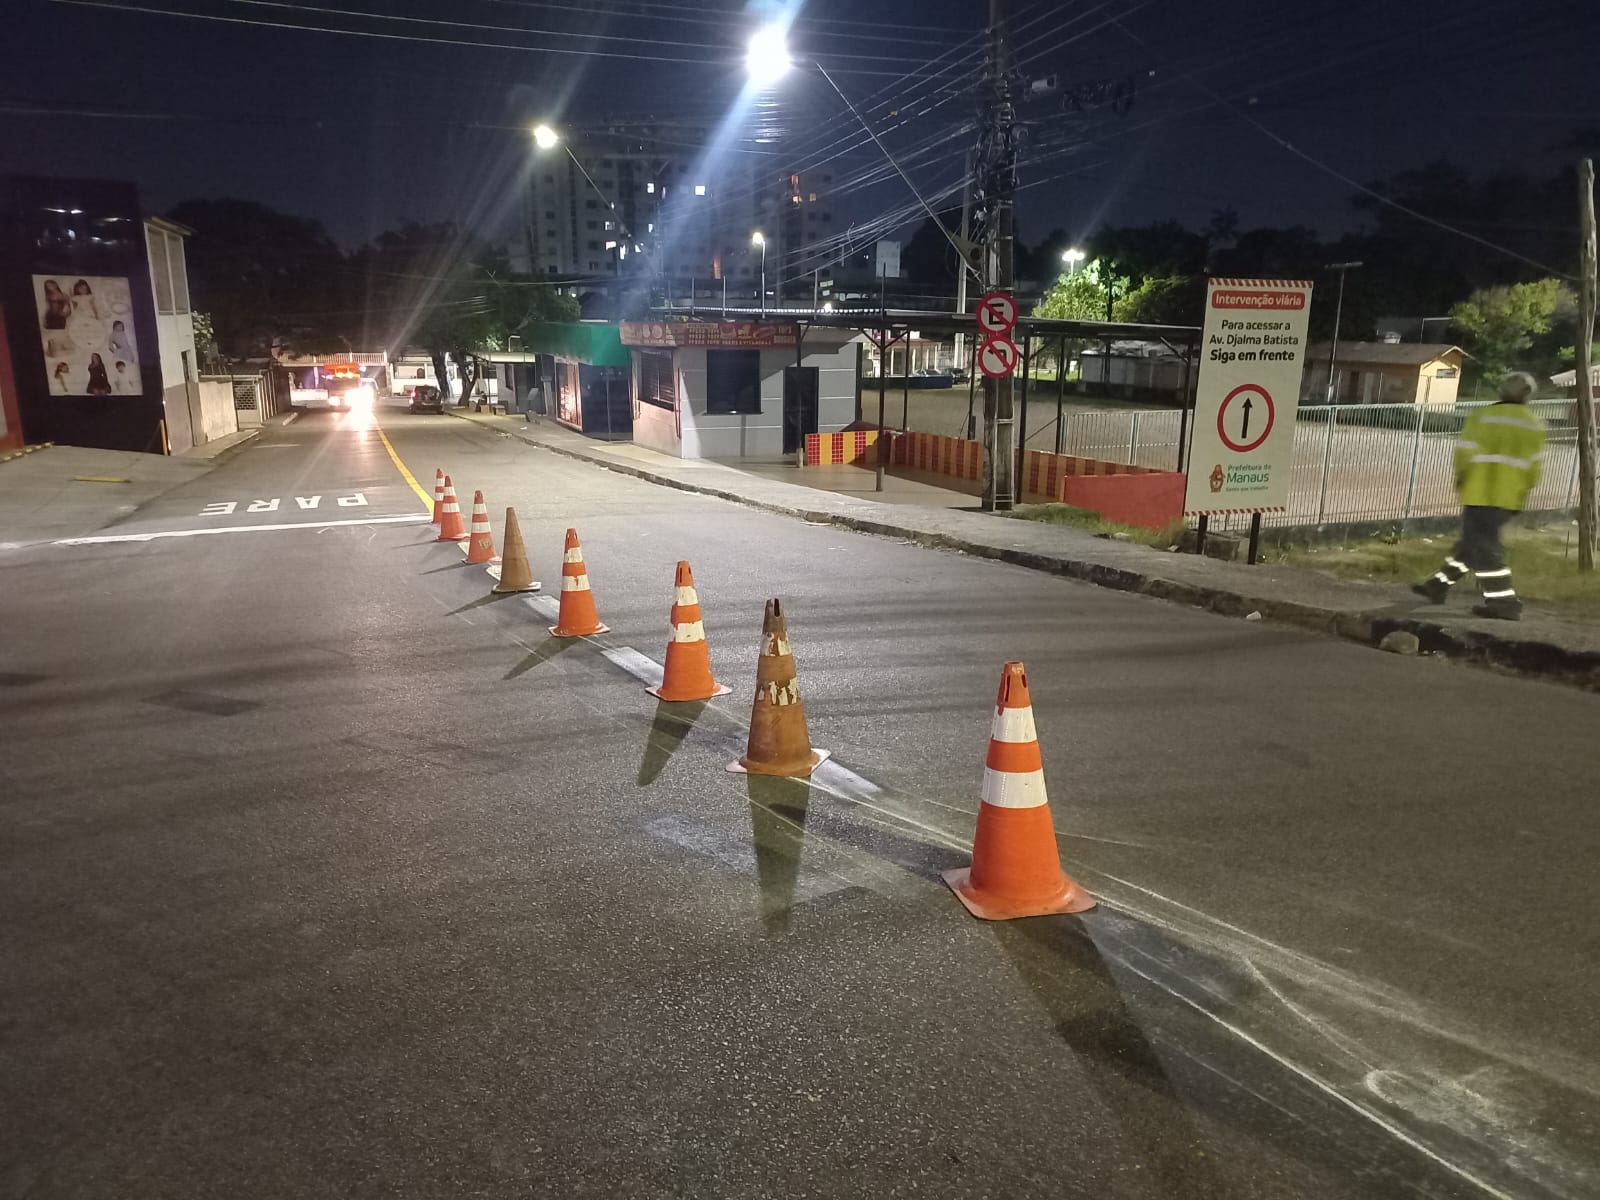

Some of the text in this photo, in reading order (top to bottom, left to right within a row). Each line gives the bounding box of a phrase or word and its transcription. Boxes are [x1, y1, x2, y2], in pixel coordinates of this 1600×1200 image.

[1215, 293, 1302, 308] Intervenção viária
[1221, 319, 1291, 331] Para acessar a
[1209, 334, 1299, 347] Av. Djalma Batista
[1210, 348, 1295, 364] Siga em frente
[1227, 464, 1262, 472] Prefeitura
[1226, 472, 1270, 483] Manaus
[198, 493, 369, 516] PARE
